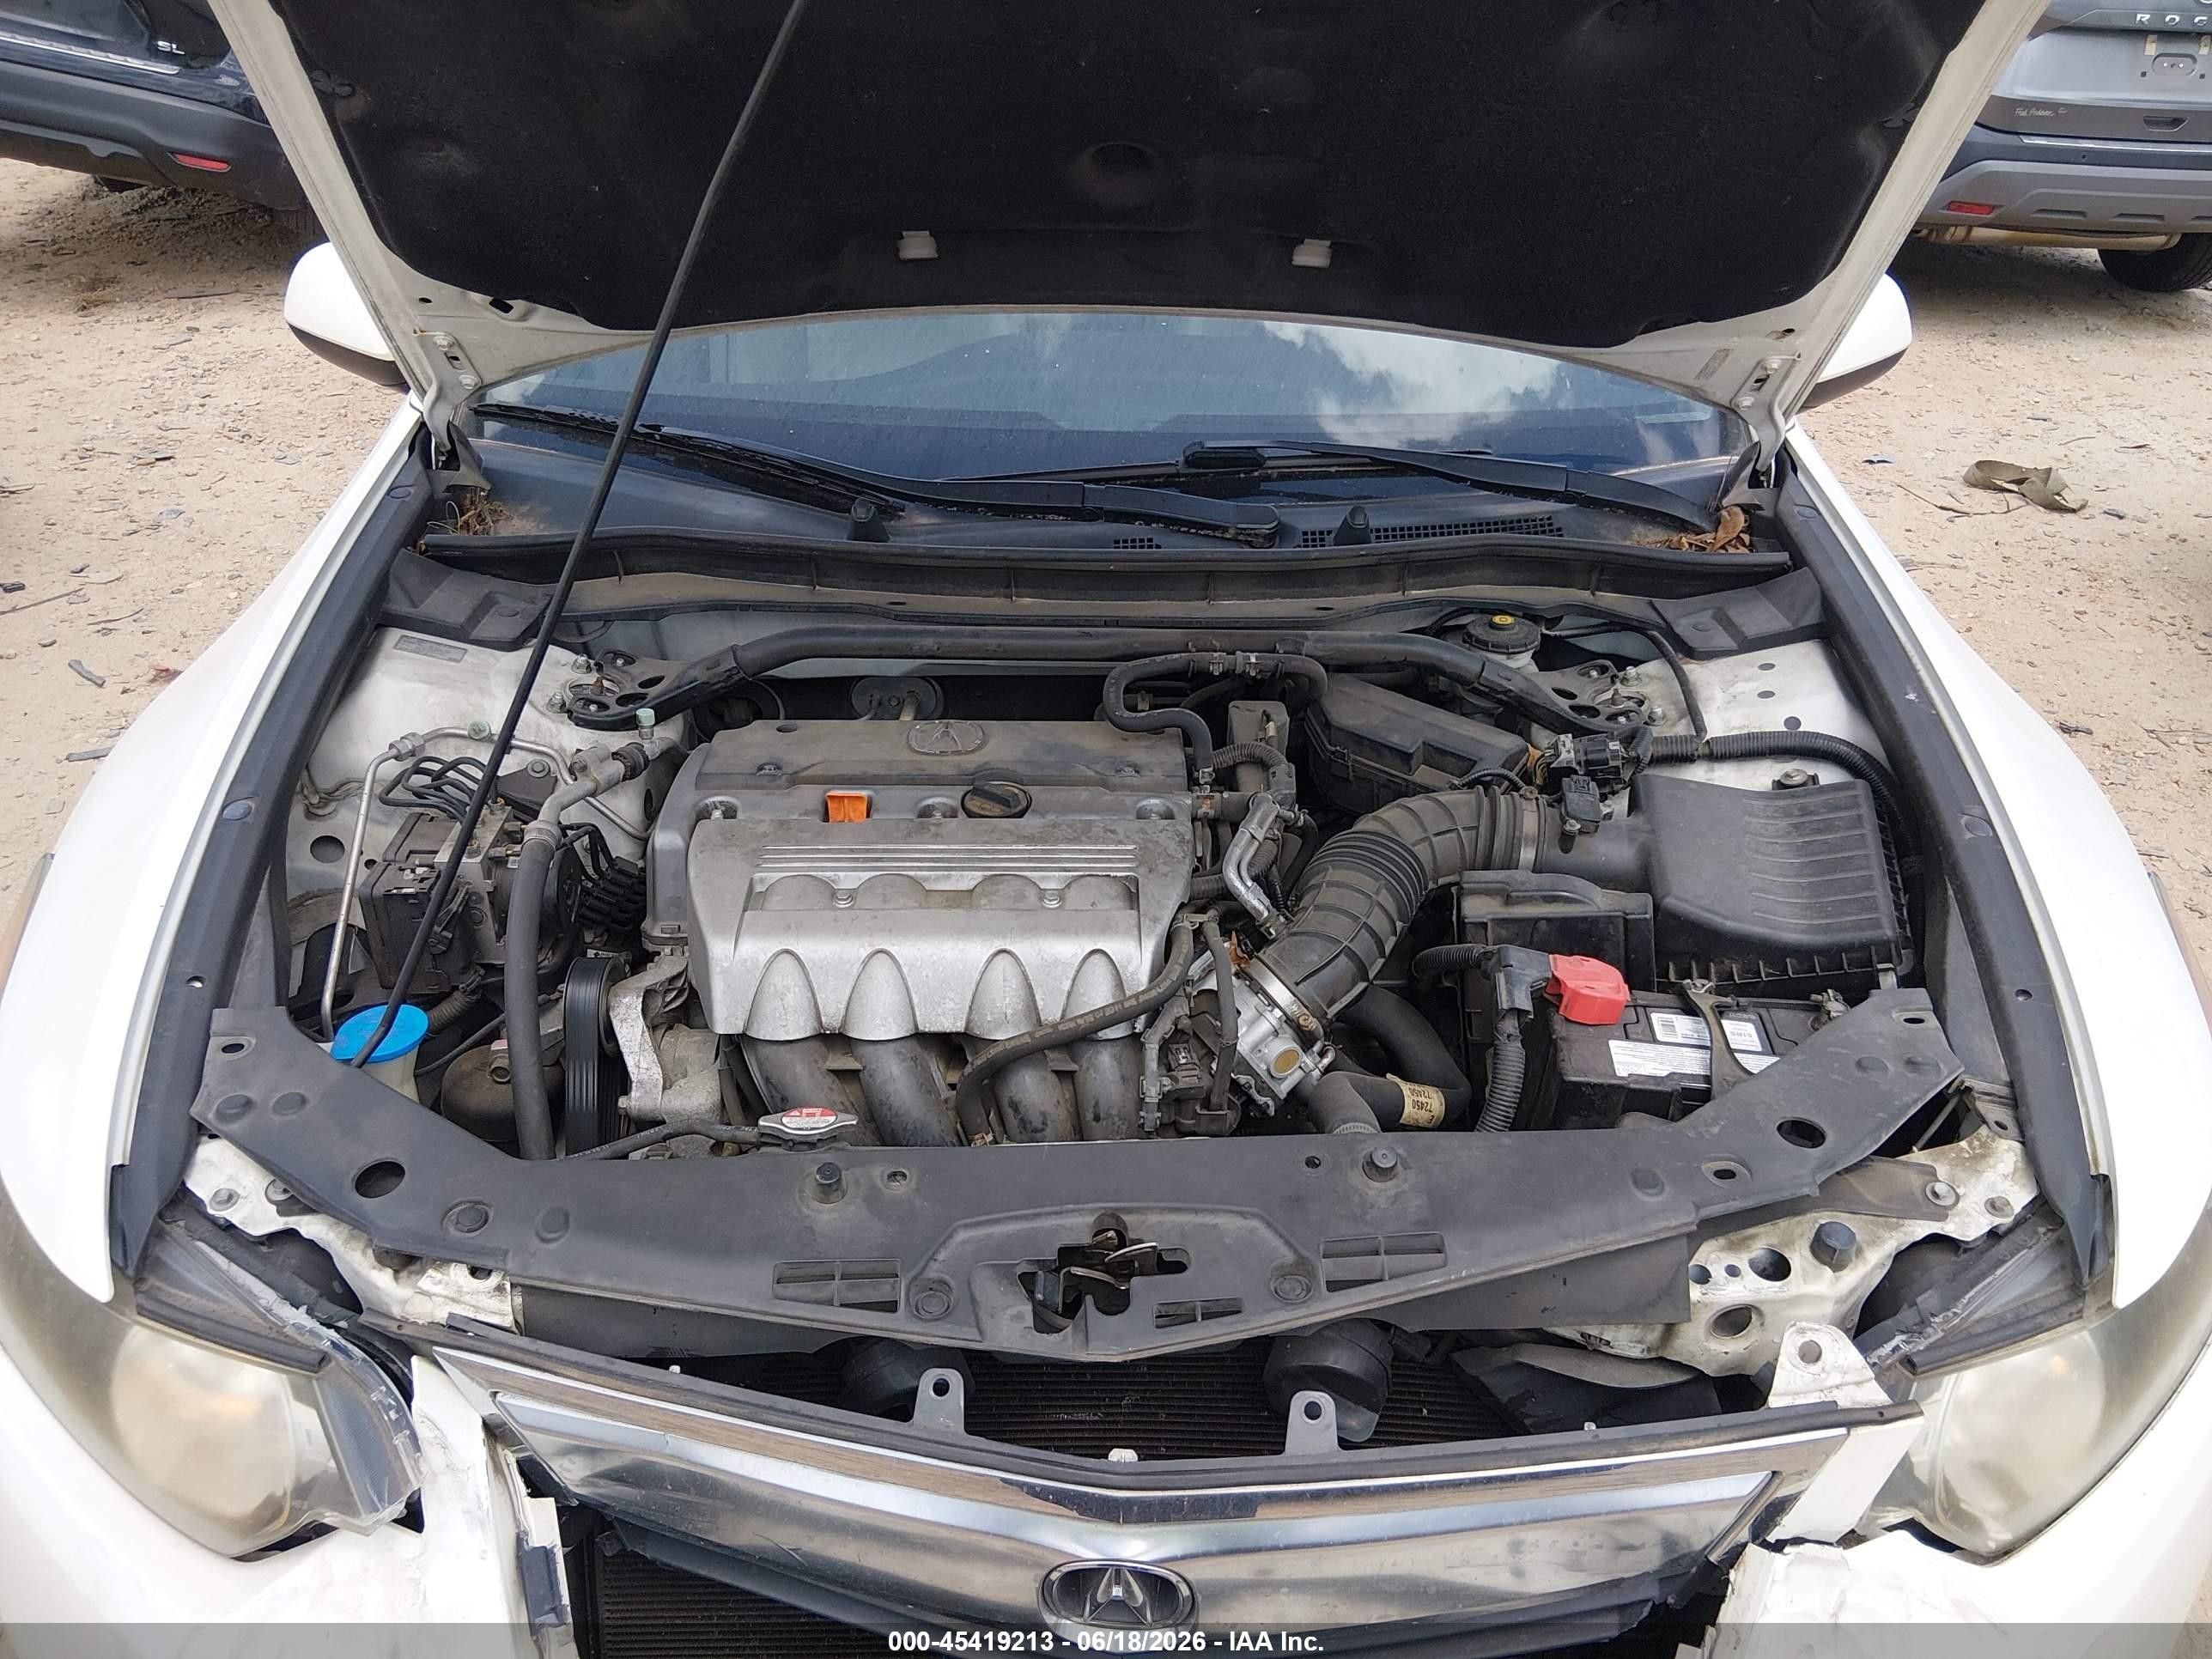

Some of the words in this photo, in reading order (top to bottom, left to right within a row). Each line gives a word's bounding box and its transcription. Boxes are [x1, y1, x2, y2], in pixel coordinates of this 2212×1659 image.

[157, 40, 185, 55] SL
[1412, 1100, 1432, 1113] 72450
[1427, 1115, 1434, 1124] E
